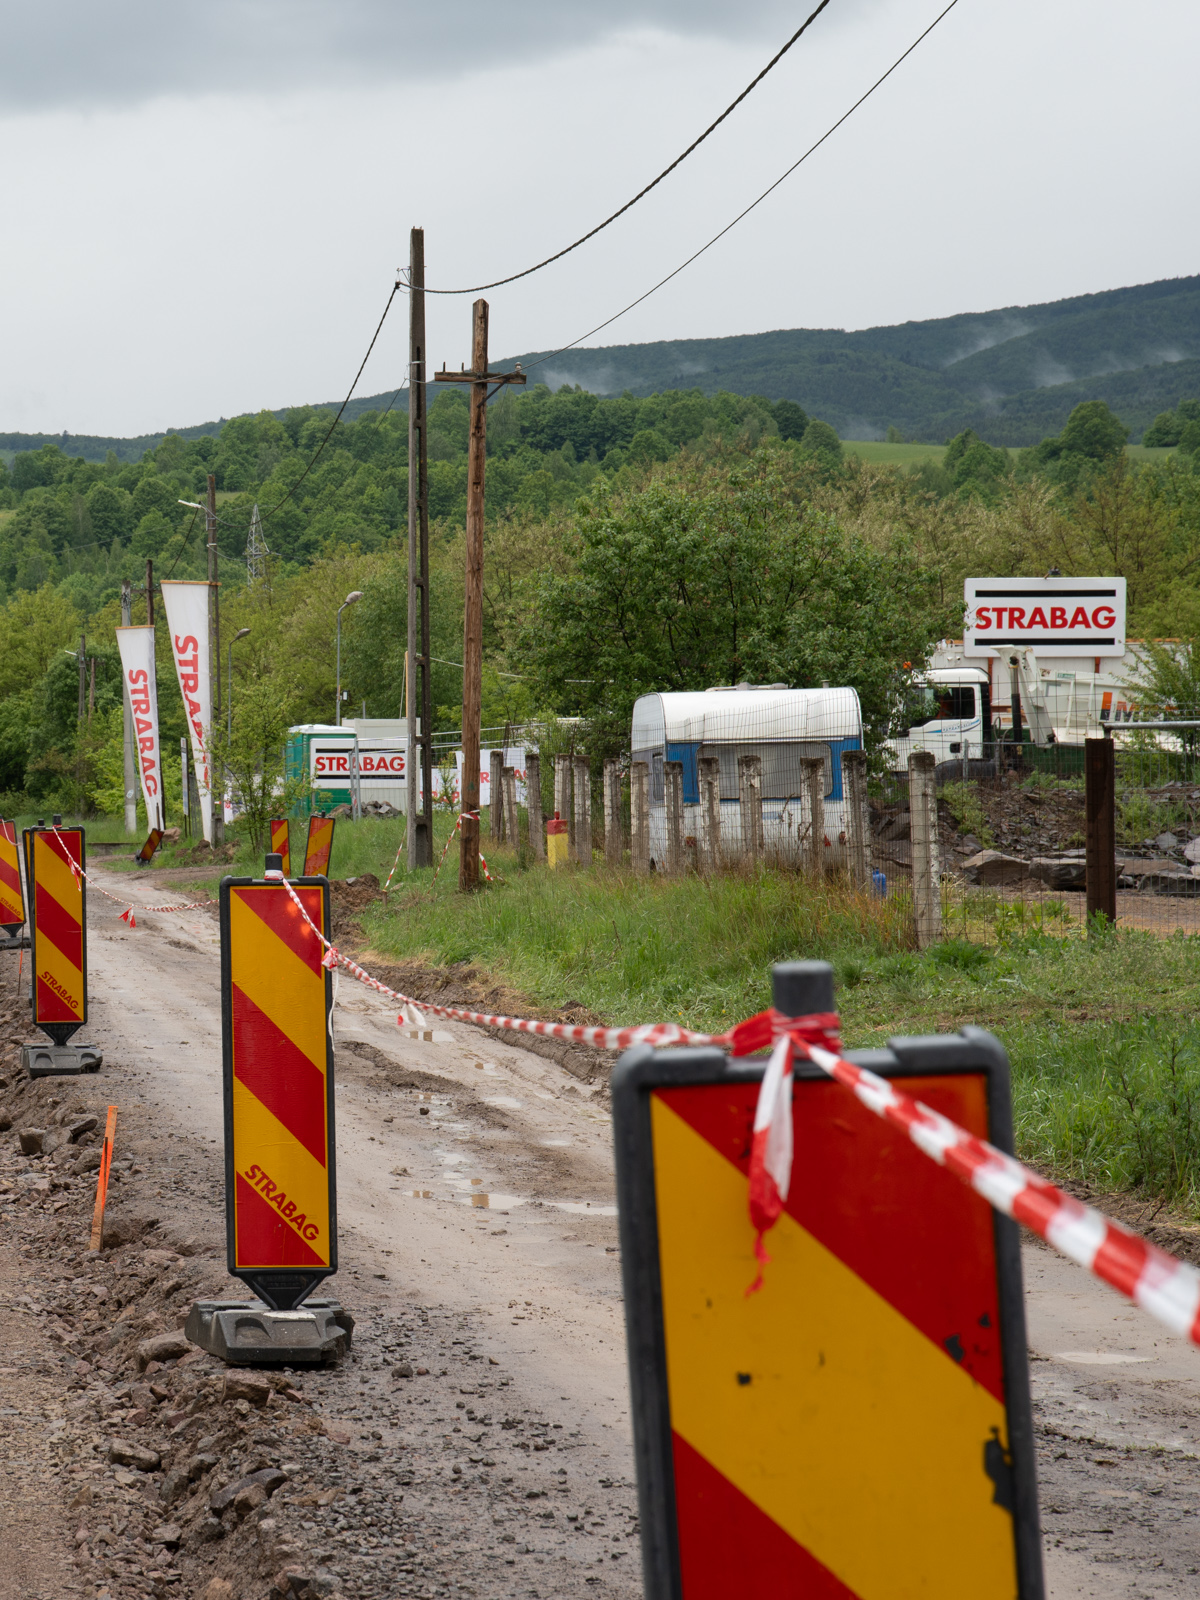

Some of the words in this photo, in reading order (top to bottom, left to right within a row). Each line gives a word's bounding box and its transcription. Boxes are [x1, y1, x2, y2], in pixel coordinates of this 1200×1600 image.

[974, 605, 1117, 630] STRABAG
[128, 669, 158, 798] STRABAG
[315, 755, 406, 773] STRABAG
[0, 897, 22, 916] STRABAG
[41, 971, 79, 1009] STRABAG
[244, 1164, 320, 1241] STRABAG
